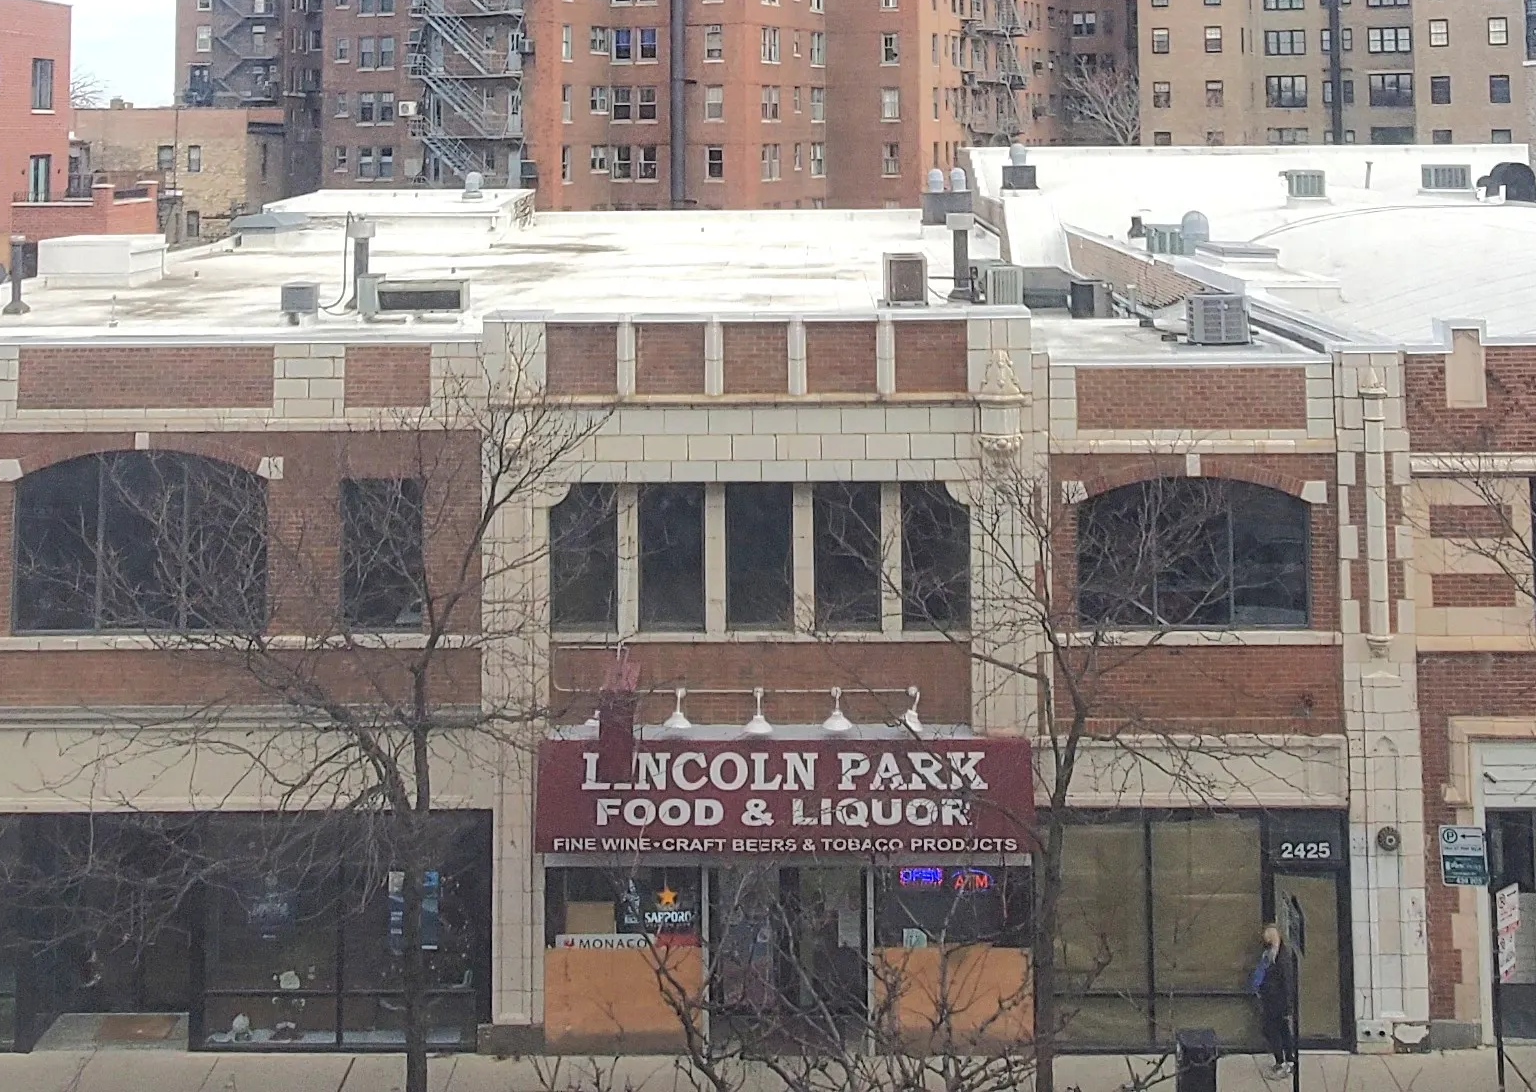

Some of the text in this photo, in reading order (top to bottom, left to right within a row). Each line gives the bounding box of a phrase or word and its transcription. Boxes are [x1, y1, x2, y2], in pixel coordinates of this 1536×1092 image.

[581, 751, 989, 791] LNCOLN PARK
[596, 798, 973, 827] FOOD & LIQUOR
[553, 838, 597, 851] FINE
[732, 838, 798, 852] BEERS
[802, 838, 816, 851] &
[910, 838, 1018, 851] PRODUCTS
[1281, 842, 1331, 859] 2425
[644, 911, 692, 924] SAPPORO
[578, 938, 648, 950] MONACO
